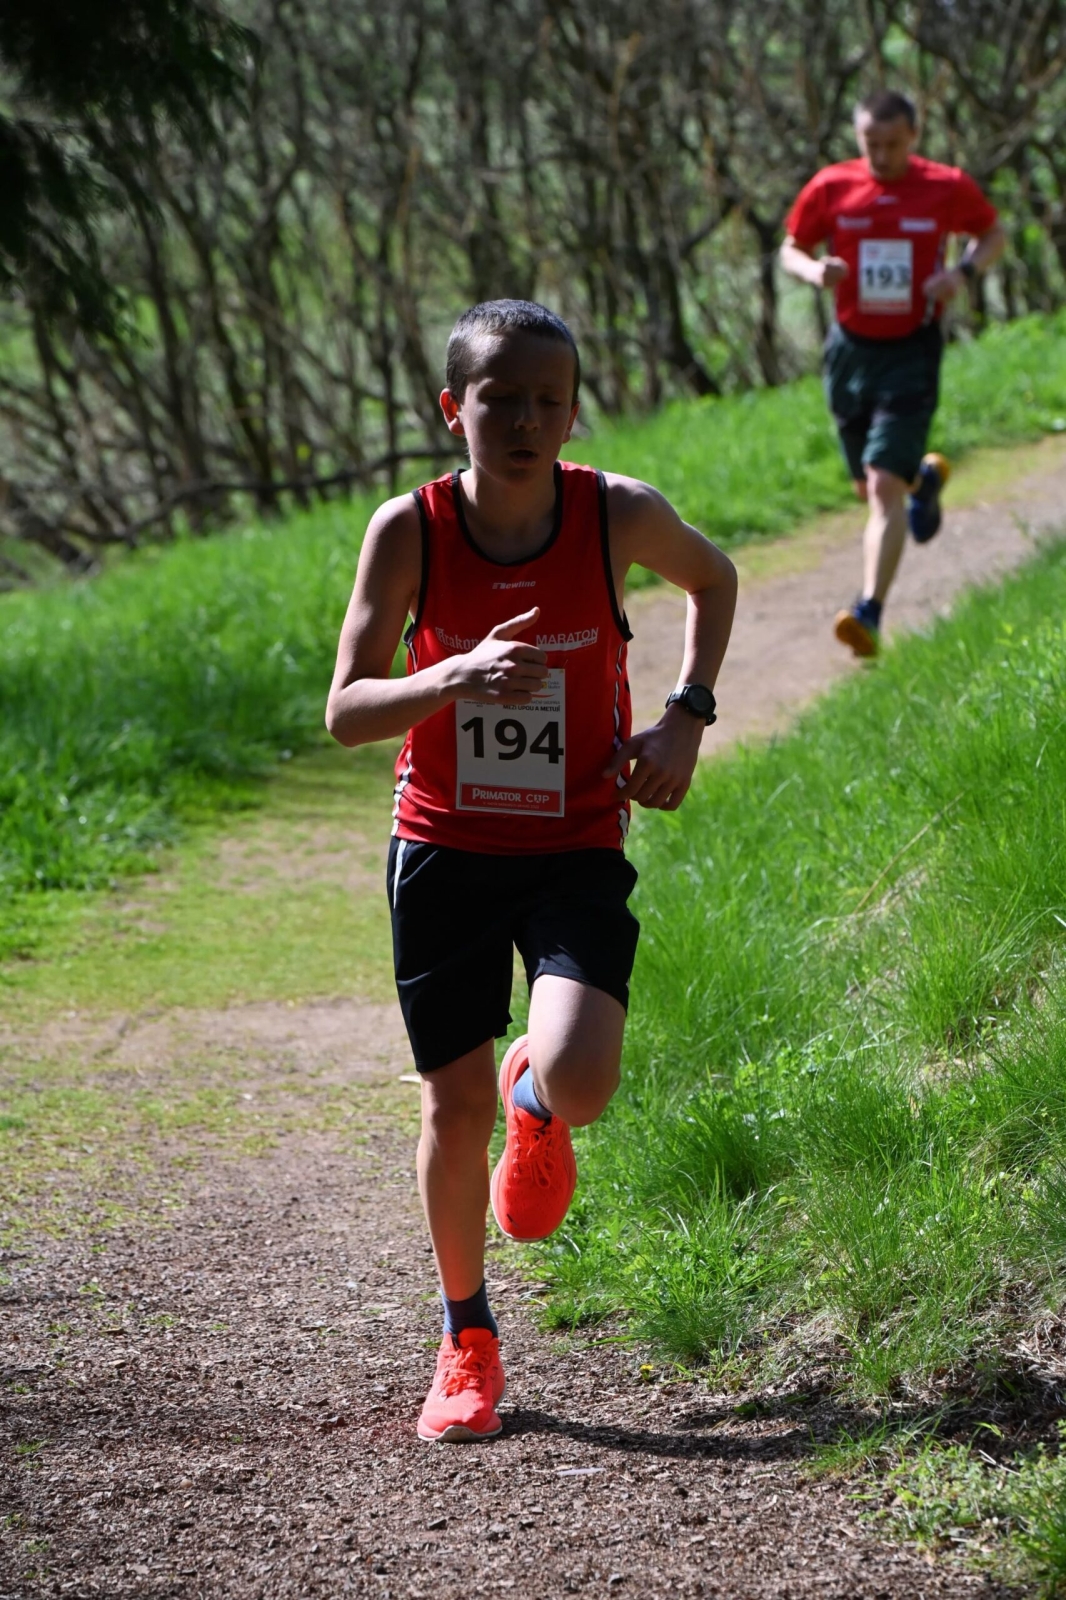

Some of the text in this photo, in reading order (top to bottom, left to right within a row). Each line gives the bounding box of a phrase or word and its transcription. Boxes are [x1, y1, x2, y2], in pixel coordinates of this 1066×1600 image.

[864, 264, 910, 290] 193
[435, 626, 482, 651] Krakon
[536, 626, 599, 646] MARATON
[461, 716, 564, 764] 194
[525, 793, 550, 804] CUP
